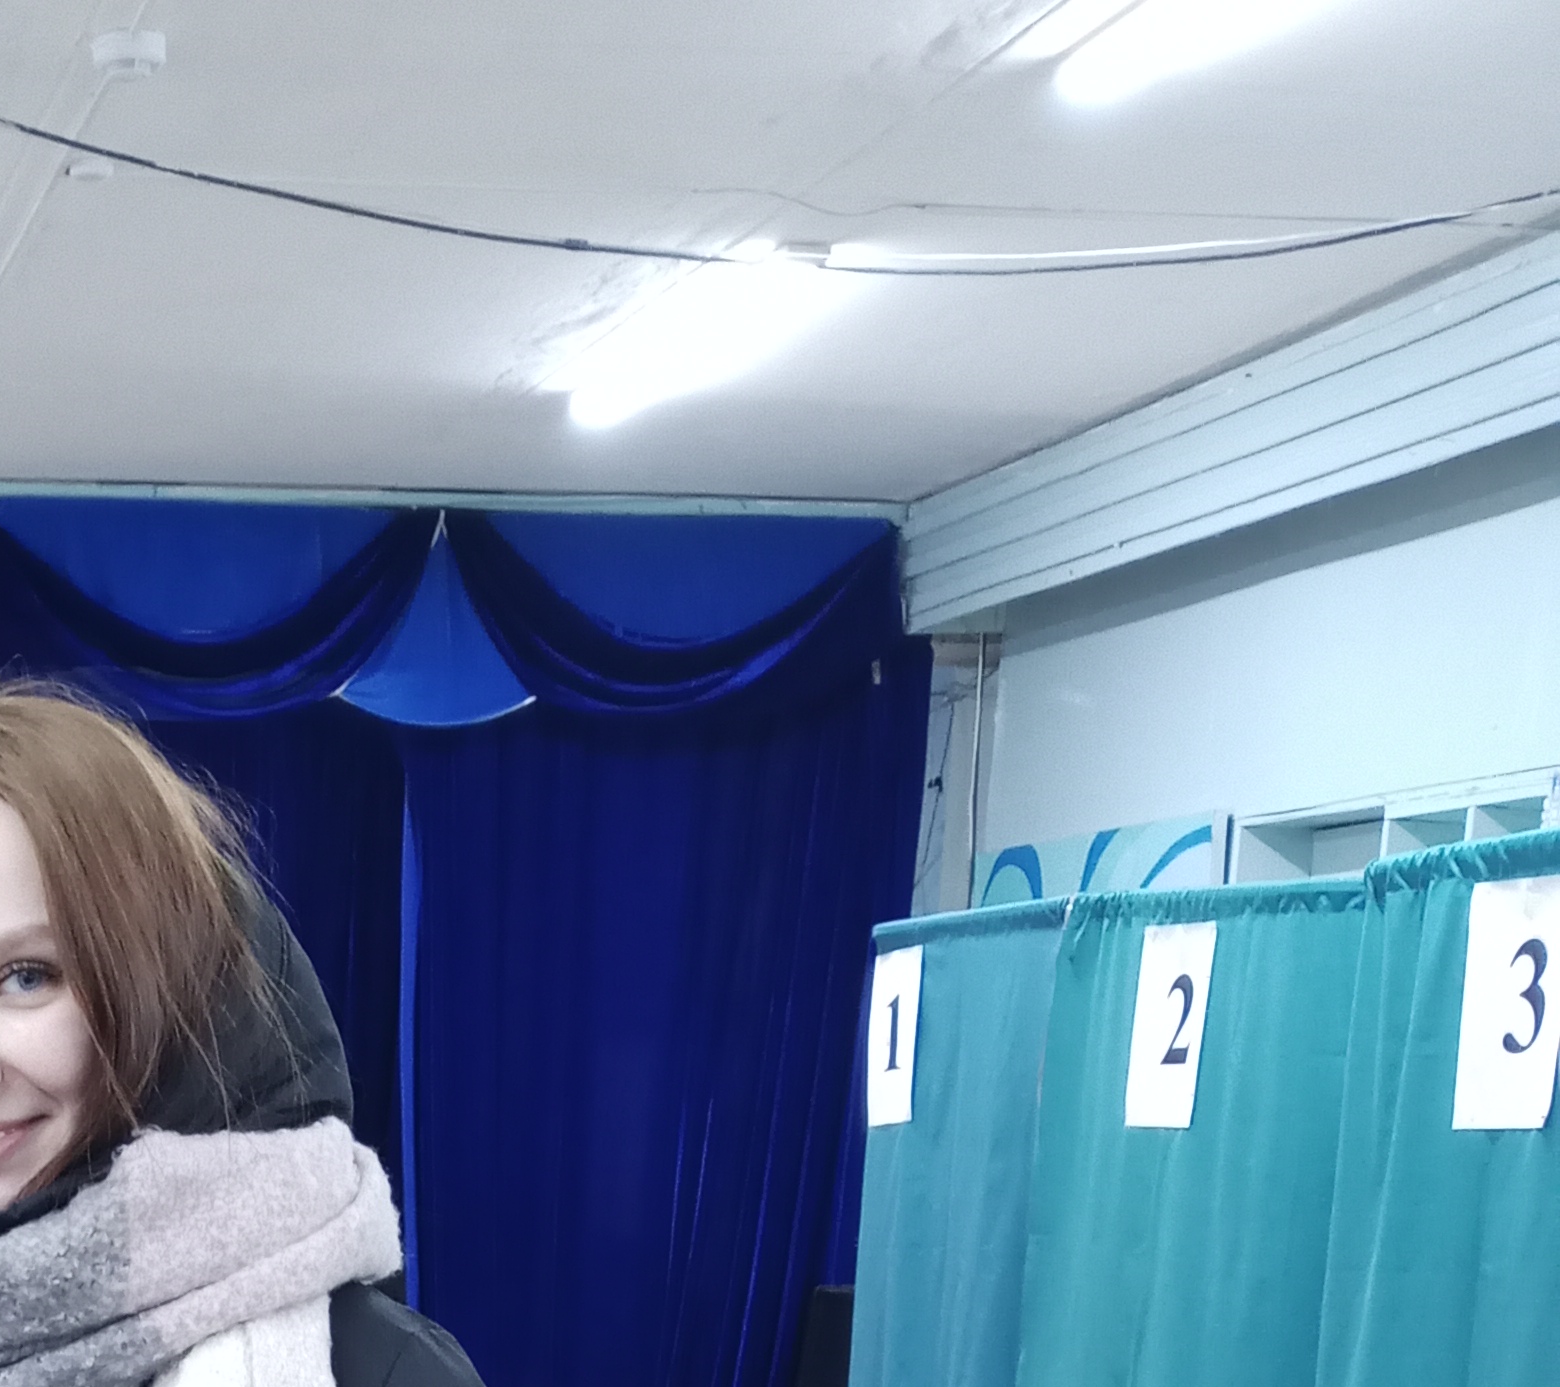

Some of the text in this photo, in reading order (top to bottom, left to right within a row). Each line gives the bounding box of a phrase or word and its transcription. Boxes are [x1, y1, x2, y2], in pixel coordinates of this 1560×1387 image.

[884, 994, 899, 1072] 1
[1160, 974, 1194, 1065] 2
[1502, 938, 1548, 1054] 3
